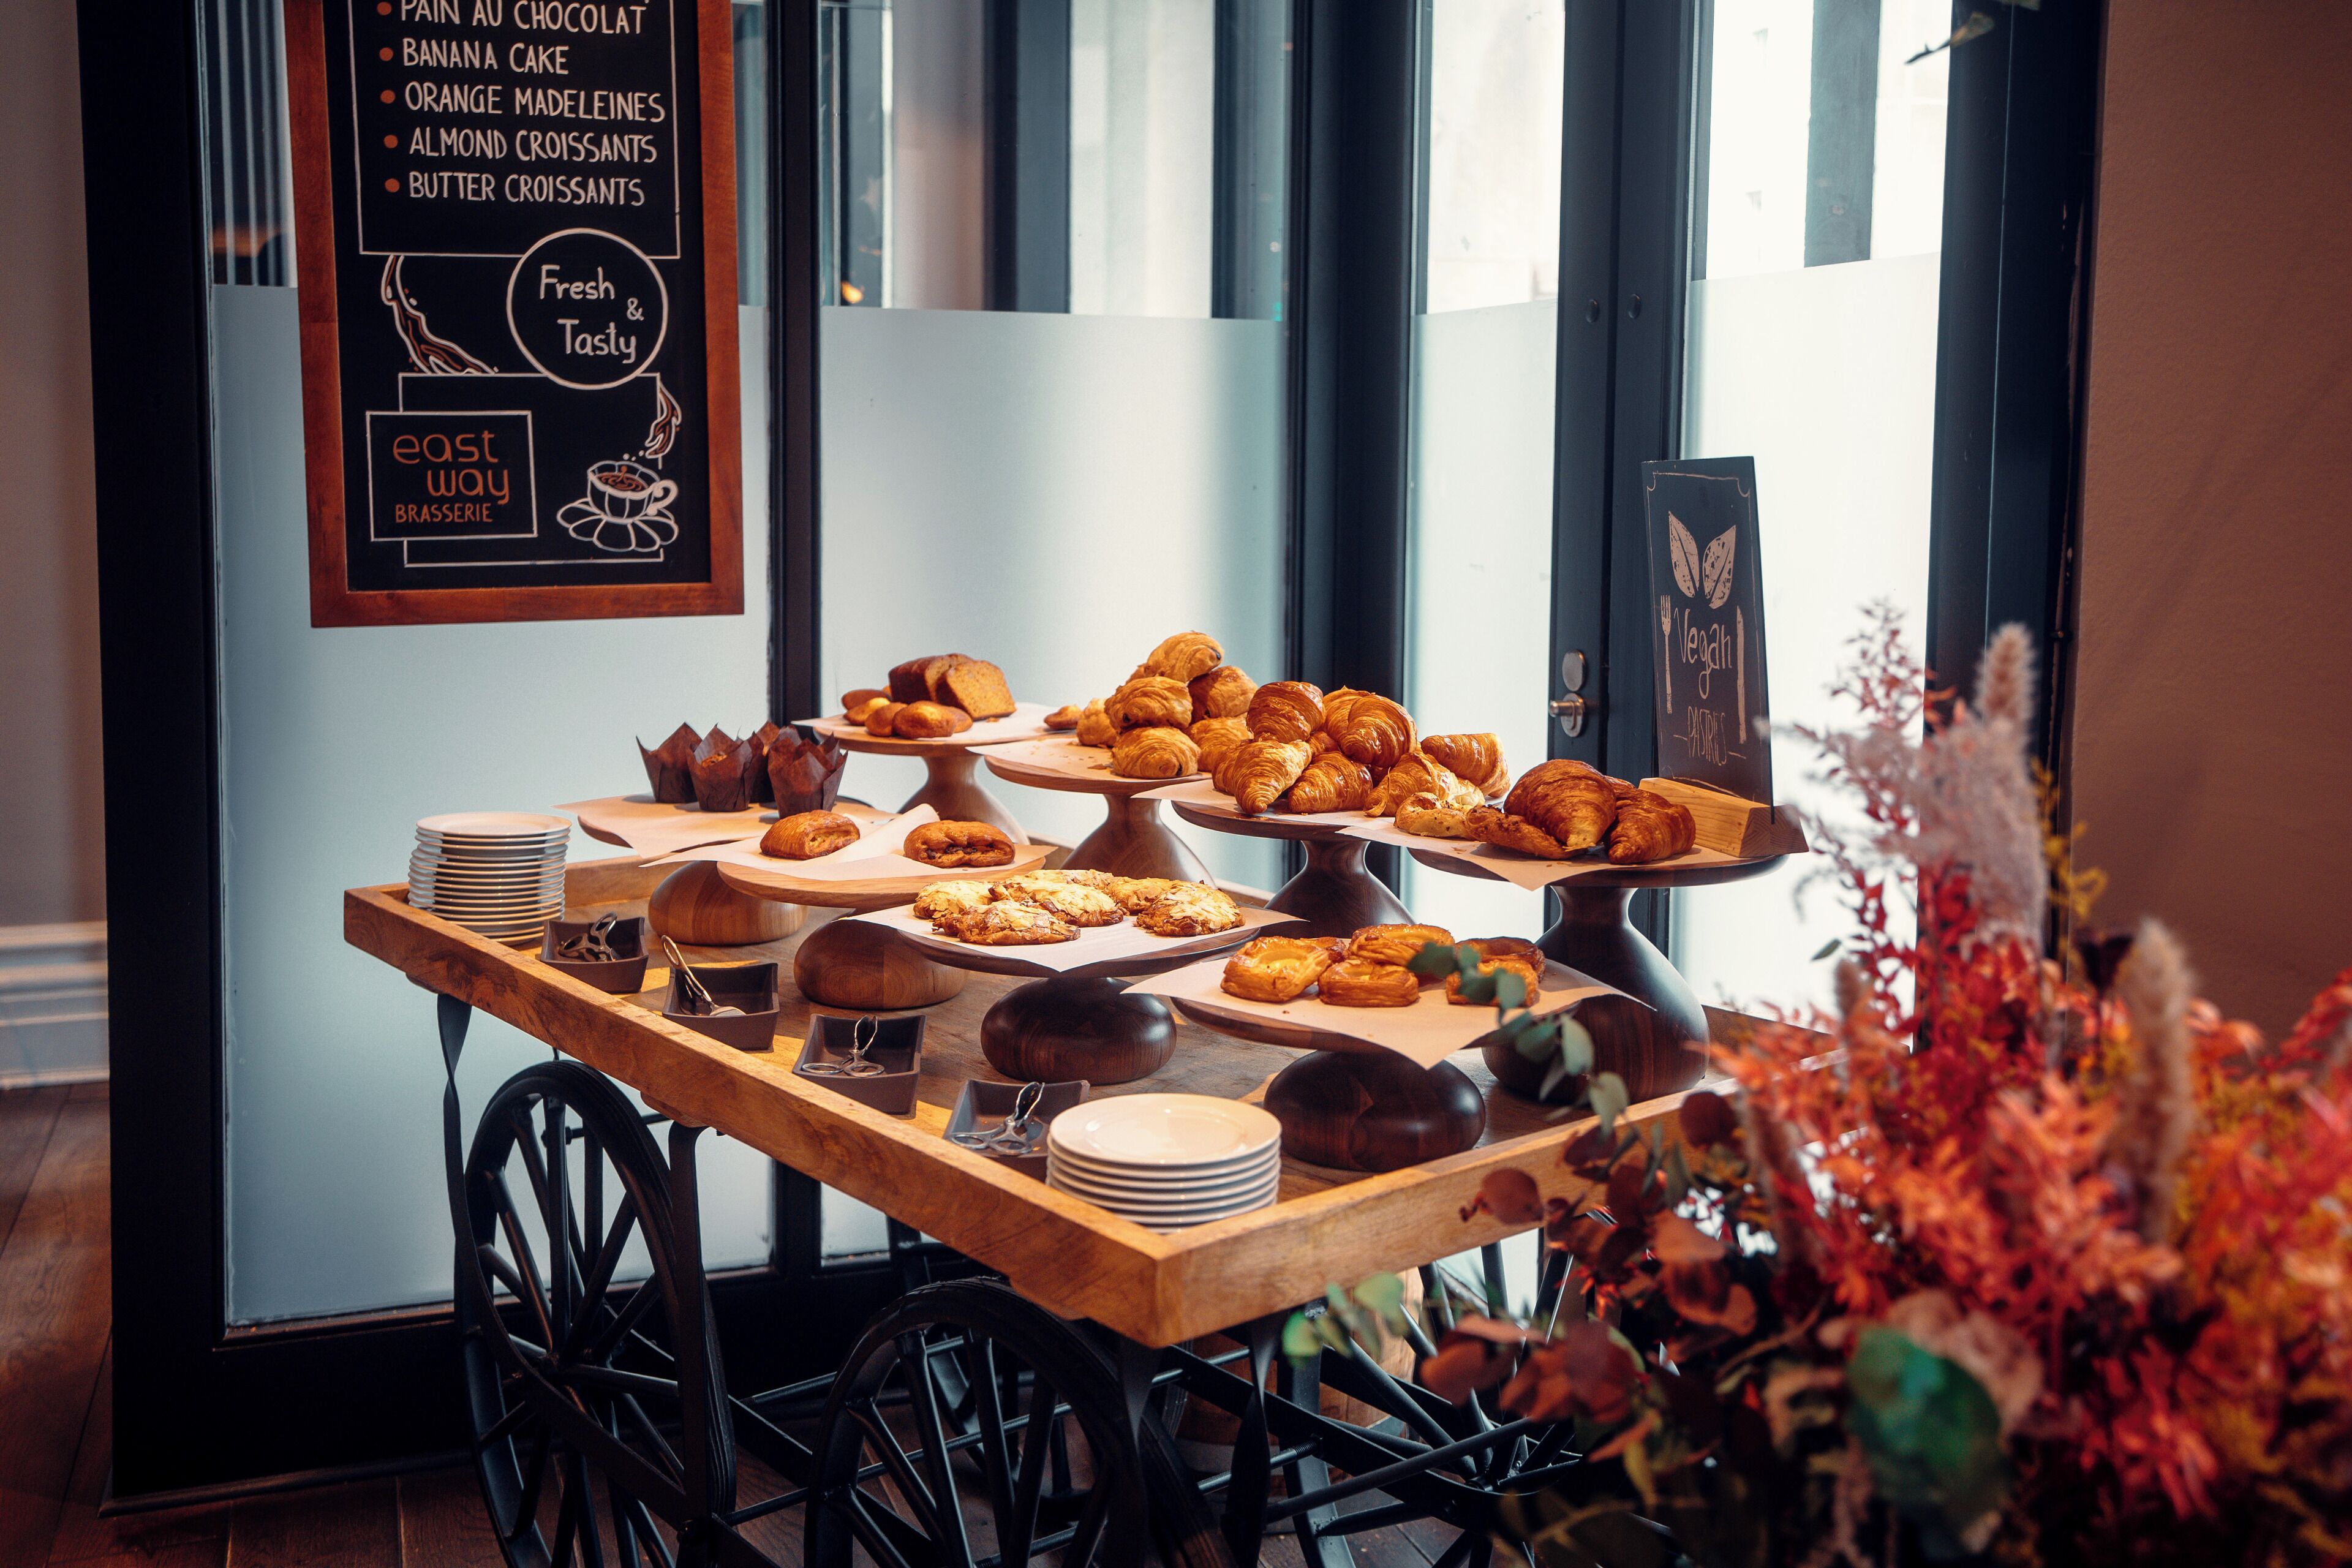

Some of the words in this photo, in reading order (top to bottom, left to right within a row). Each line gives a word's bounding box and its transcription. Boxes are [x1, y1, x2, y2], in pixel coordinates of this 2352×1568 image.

[401, 0, 461, 24] PAIN
[472, 0, 503, 27] AU
[513, 0, 647, 34] CHOCOLAT
[402, 37, 498, 70] BANANA
[509, 42, 570, 75] CAKE
[405, 81, 503, 114] ORANGE
[514, 87, 666, 123] MADELEINES
[409, 126, 508, 159] ALMOND
[515, 129, 657, 163] CROISSANTS
[409, 171, 496, 202] BUTTER
[505, 173, 645, 206] CROISSANTS
[539, 264, 616, 300] Fresh
[626, 297, 644, 321] &
[557, 318, 637, 364] Tasty
[393, 430, 499, 465] east
[427, 468, 510, 505] way
[395, 503, 494, 524] BRASSERIE
[1673, 607, 1733, 699] Vegan
